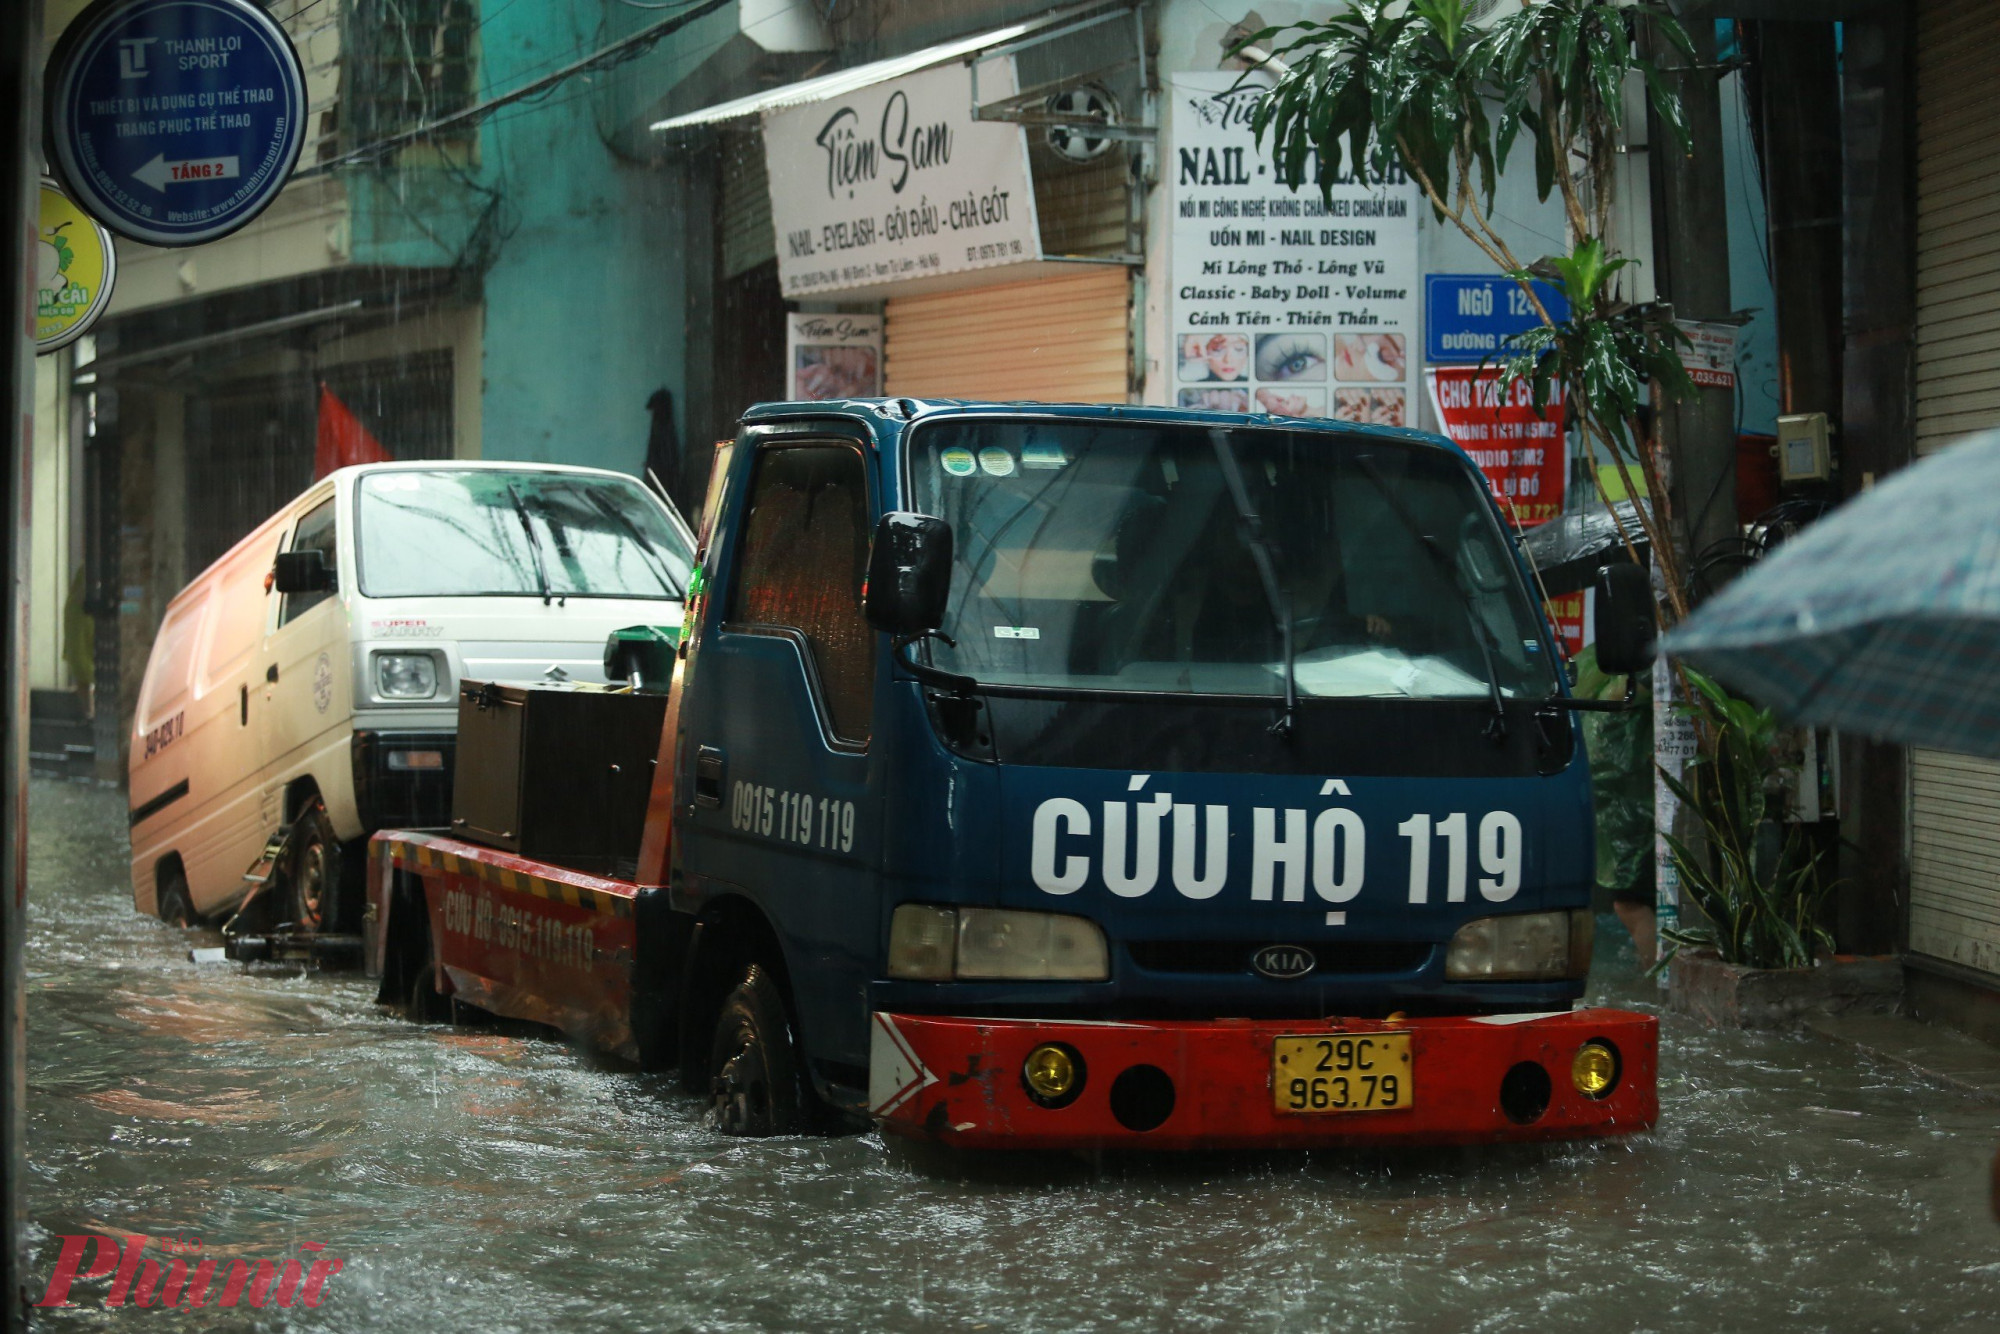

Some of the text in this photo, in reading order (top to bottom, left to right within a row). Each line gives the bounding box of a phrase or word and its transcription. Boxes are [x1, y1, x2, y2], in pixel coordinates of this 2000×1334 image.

[164, 38, 215, 55] THANH
[178, 53, 230, 71] SPORT
[242, 87, 274, 104] THAO
[115, 120, 156, 138] TRANG
[219, 113, 251, 130] THAO
[815, 90, 954, 200] Tiệm Sam
[215, 163, 224, 176] 2
[1178, 146, 1251, 186] NAIL
[167, 209, 212, 222] Website:
[1199, 199, 1211, 218] MI
[1213, 196, 1239, 218] CÔNG
[1269, 196, 1300, 218] KHÔNG
[788, 228, 816, 258] NAIL
[823, 216, 876, 252] EYELASH
[885, 204, 909, 246] GỘI
[949, 189, 980, 231] CHÀ
[980, 184, 1010, 226] GÓT
[1209, 224, 1377, 247] UỐN MI NAIL DESIGN
[1201, 259, 1222, 275] Mi
[1227, 259, 1267, 278] Lông
[1317, 259, 1358, 278] Lông
[1179, 284, 1408, 303] Classic Baby Doll Volume
[1457, 282, 1494, 316] NGÕ
[1188, 310, 1230, 326] Cánh
[1235, 310, 1271, 326] Tiên
[1286, 310, 1333, 326] Thiên
[1441, 329, 1496, 350] ĐƯỜNG
[1440, 379, 1471, 409] CHO
[370, 619, 427, 627] SUPER
[731, 779, 856, 853] 0915 119 119
[1030, 774, 1523, 926] CỨU HỘ 119
[445, 882, 472, 936] CỨU
[1264, 953, 1305, 971] KIA
[1315, 1038, 1374, 1073] 29C
[1288, 1074, 1399, 1110] 963.79
